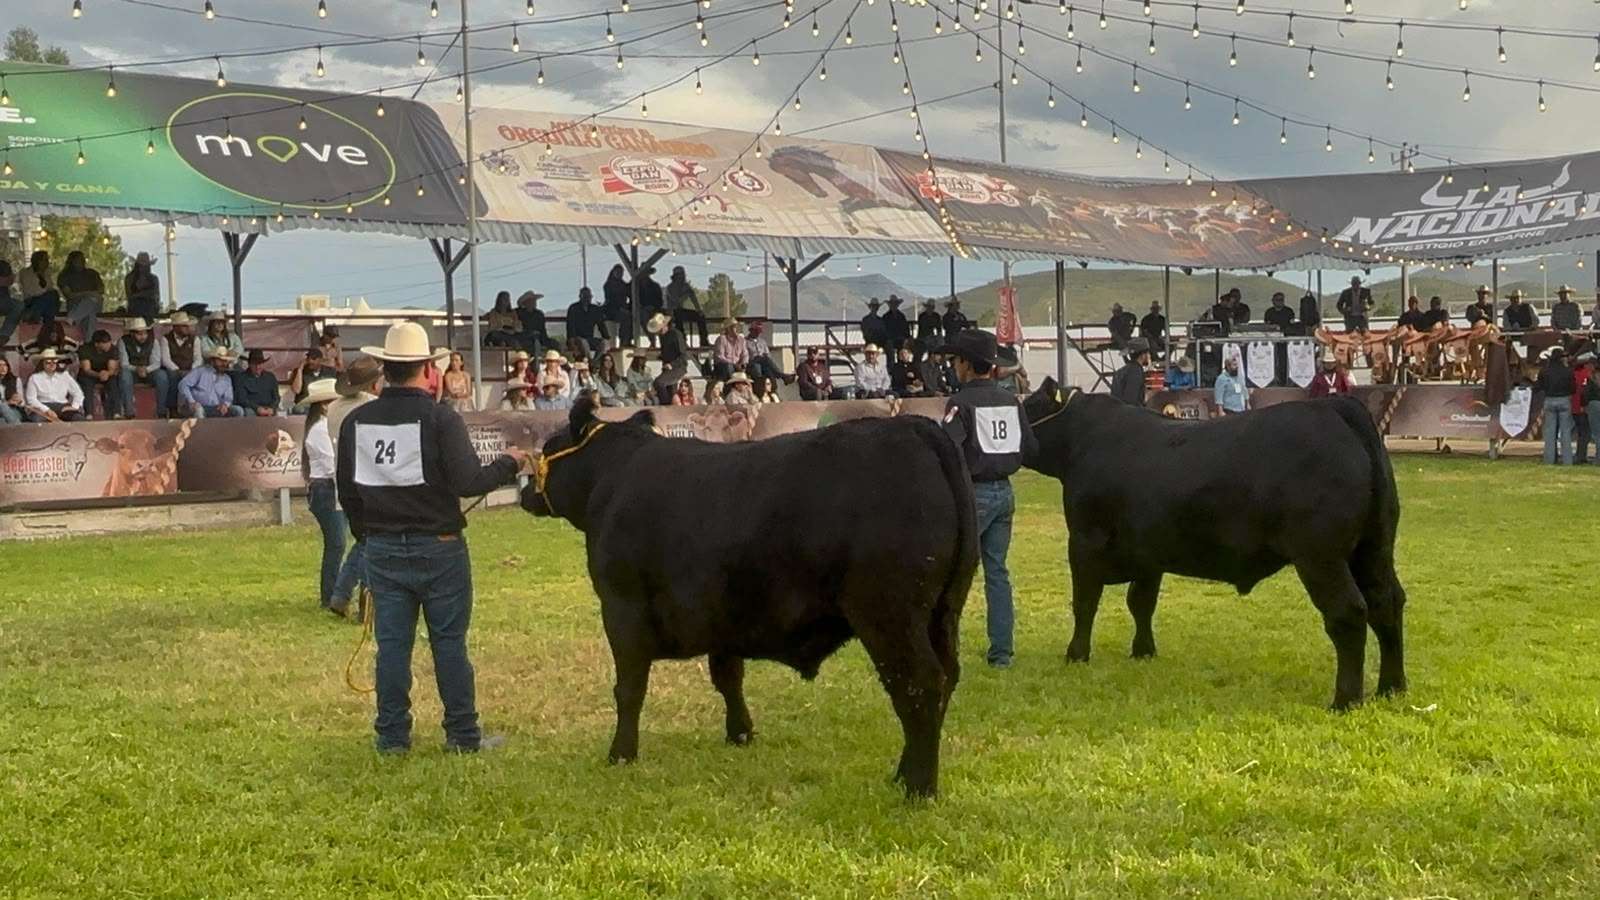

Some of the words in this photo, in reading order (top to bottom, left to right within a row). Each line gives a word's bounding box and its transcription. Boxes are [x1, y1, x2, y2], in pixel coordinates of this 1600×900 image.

[497, 124, 602, 148] ORGULLO
[196, 134, 368, 165] move
[34, 181, 49, 191] Y
[56, 183, 120, 194] GANA
[1332, 191, 1600, 246] NACIONAL
[1383, 240, 1464, 254] PRESTIGIO
[1468, 236, 1491, 247] EN
[1494, 228, 1546, 242] CARNE
[991, 420, 1007, 440] 18
[375, 439, 396, 465] 24
[4, 471, 69, 480] MEXICANO
